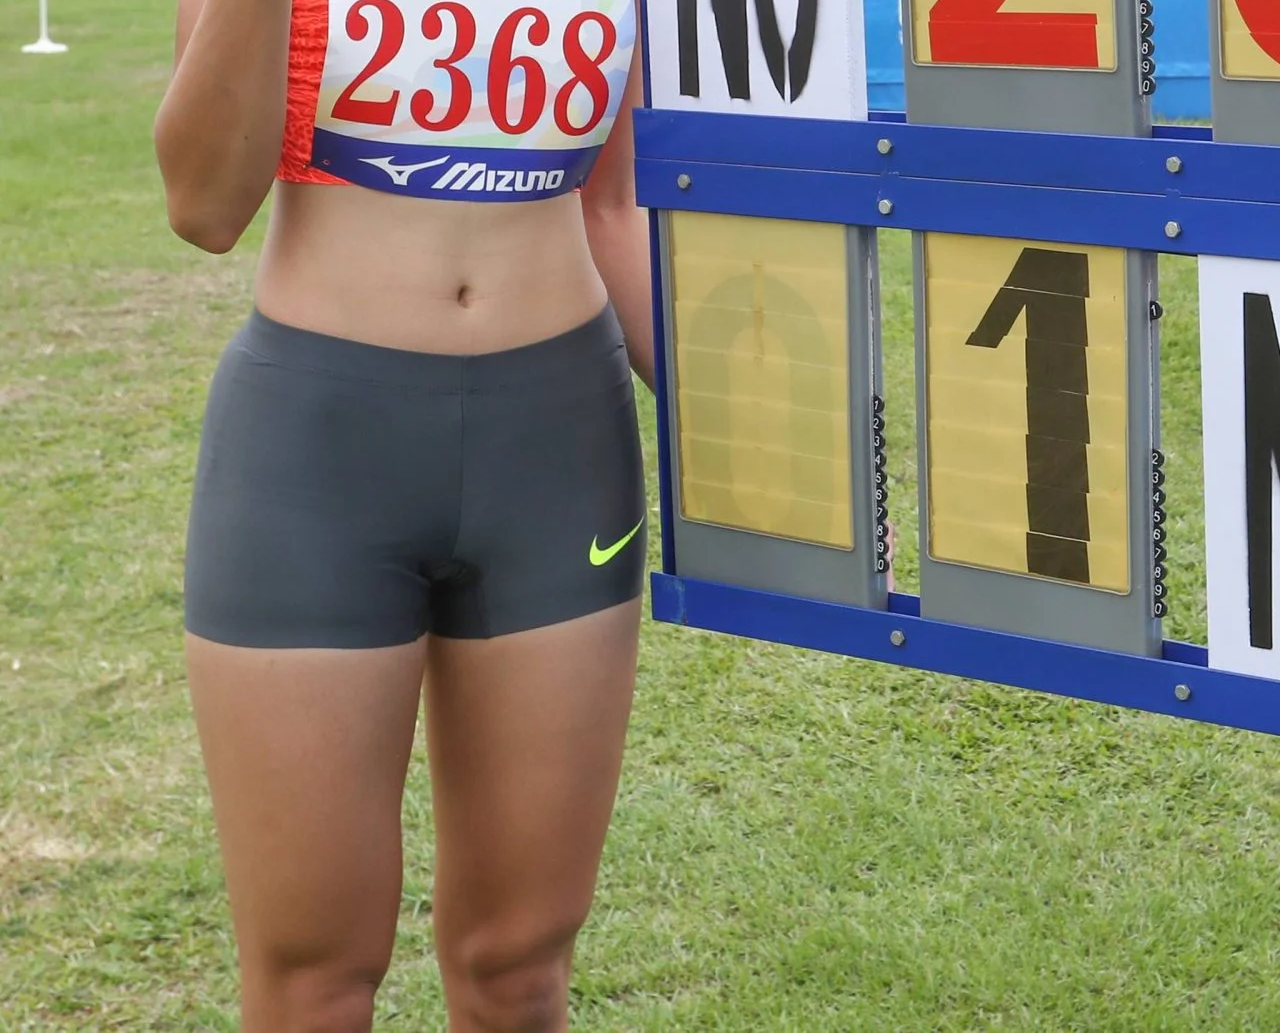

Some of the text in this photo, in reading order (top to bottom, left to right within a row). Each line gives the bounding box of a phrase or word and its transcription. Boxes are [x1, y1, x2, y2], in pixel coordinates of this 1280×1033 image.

[1140, 3, 1146, 14] 6
[1142, 23, 1148, 34] 7
[1142, 42, 1148, 54] 8
[1142, 61, 1149, 72] 9
[1143, 80, 1150, 92] 0
[1151, 305, 1156, 316] 1
[964, 246, 1091, 584] 1
[874, 401, 884, 569] 1 2 3 4 5 6 7 8 9 0
[1152, 453, 1162, 614] 2 3 4 5 6 7 8 9 0
